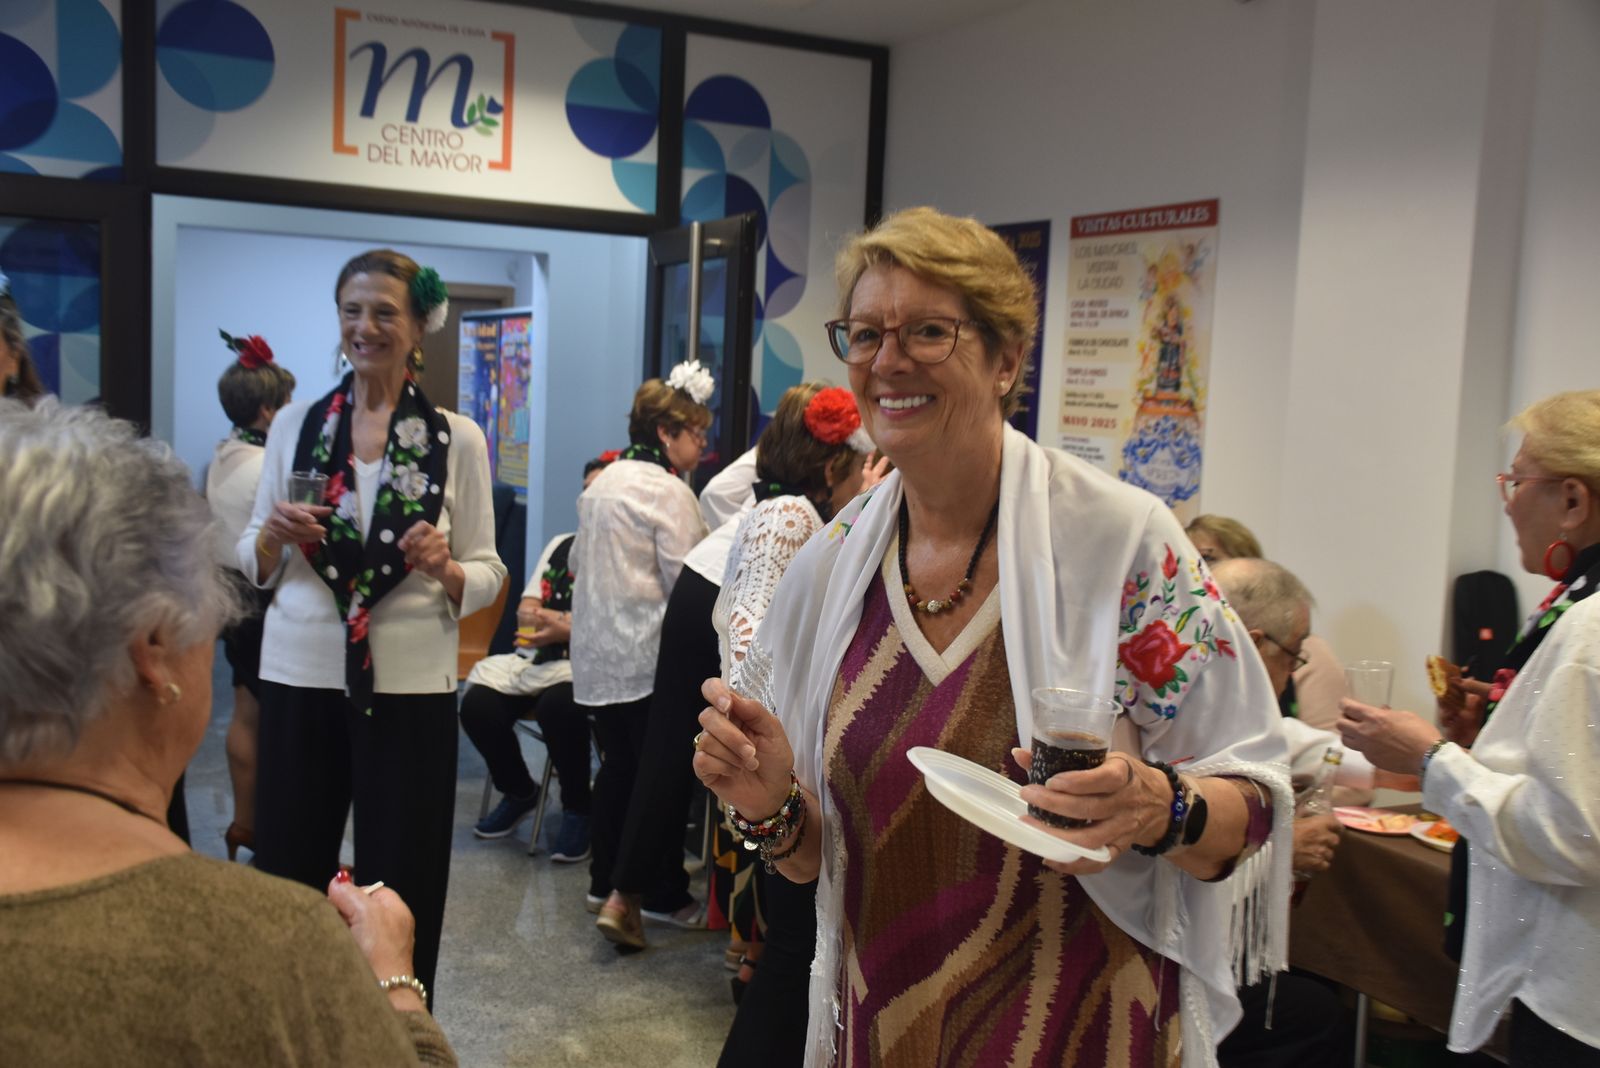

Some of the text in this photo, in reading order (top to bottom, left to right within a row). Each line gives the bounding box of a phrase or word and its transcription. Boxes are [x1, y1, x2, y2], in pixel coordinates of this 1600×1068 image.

[381, 123, 464, 151] CENTRO
[367, 143, 482, 173] DEL MAYOR
[1076, 206, 1210, 234] VISITAS CULTURALES
[1062, 415, 1117, 429] MAYO 2025
